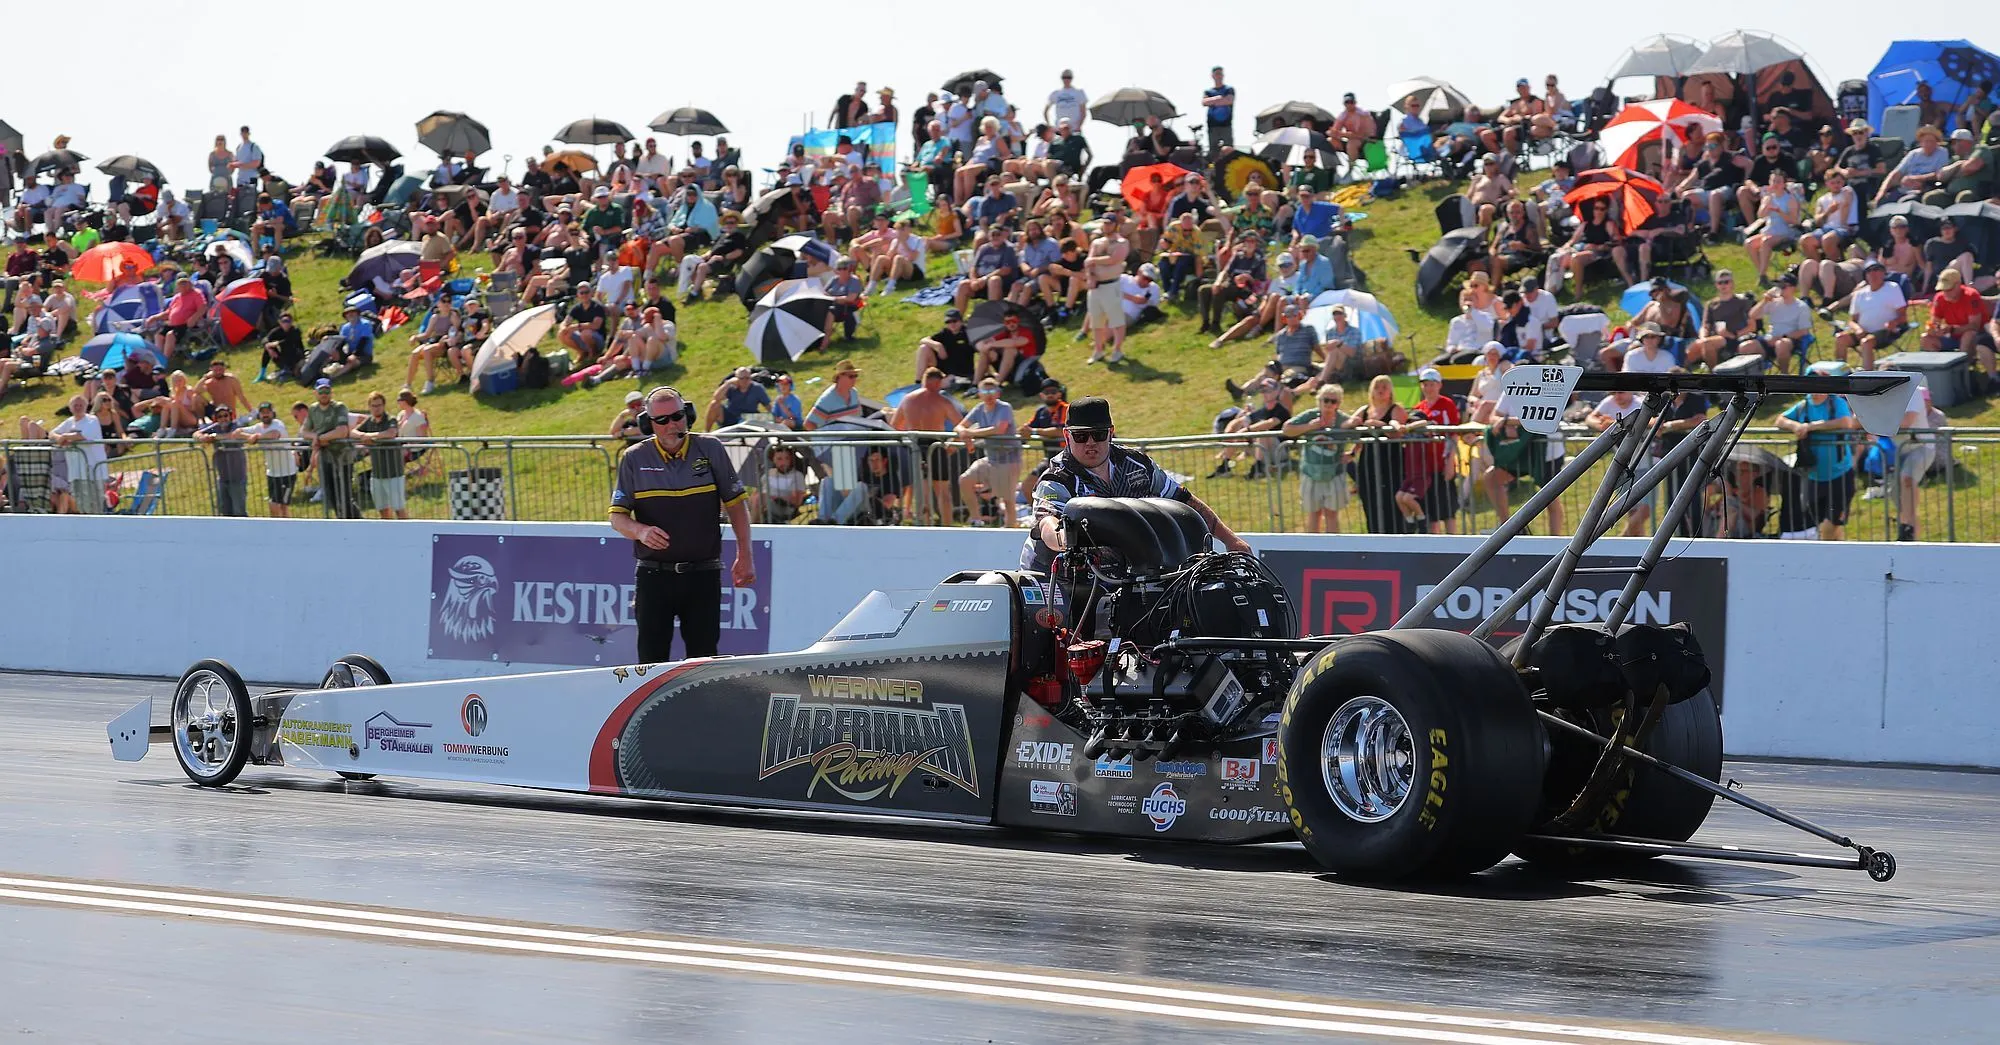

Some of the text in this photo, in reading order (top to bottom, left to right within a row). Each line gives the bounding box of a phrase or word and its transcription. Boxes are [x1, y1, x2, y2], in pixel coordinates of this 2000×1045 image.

[1522, 406, 1557, 420] 1110
[512, 581, 638, 626] KESTRE
[950, 599, 993, 612] TIMO
[807, 674, 924, 704] WERNER
[282, 719, 352, 733] AUTOKRANDIENST
[368, 728, 415, 740] BERGHEIMER
[282, 730, 353, 749] HABERMANN
[380, 739, 433, 754] STAHLHALLEN
[759, 692, 980, 798] HABERMANN
[443, 743, 509, 757] TOMMYWERBUNG
[1016, 741, 1074, 764] EXIDE
[806, 742, 949, 801] Racing
[1096, 769, 1132, 778] CARRILLO
[1225, 760, 1256, 778] B&J
[1418, 728, 1449, 832] EAGLE
[1143, 799, 1185, 814] FUCHS
